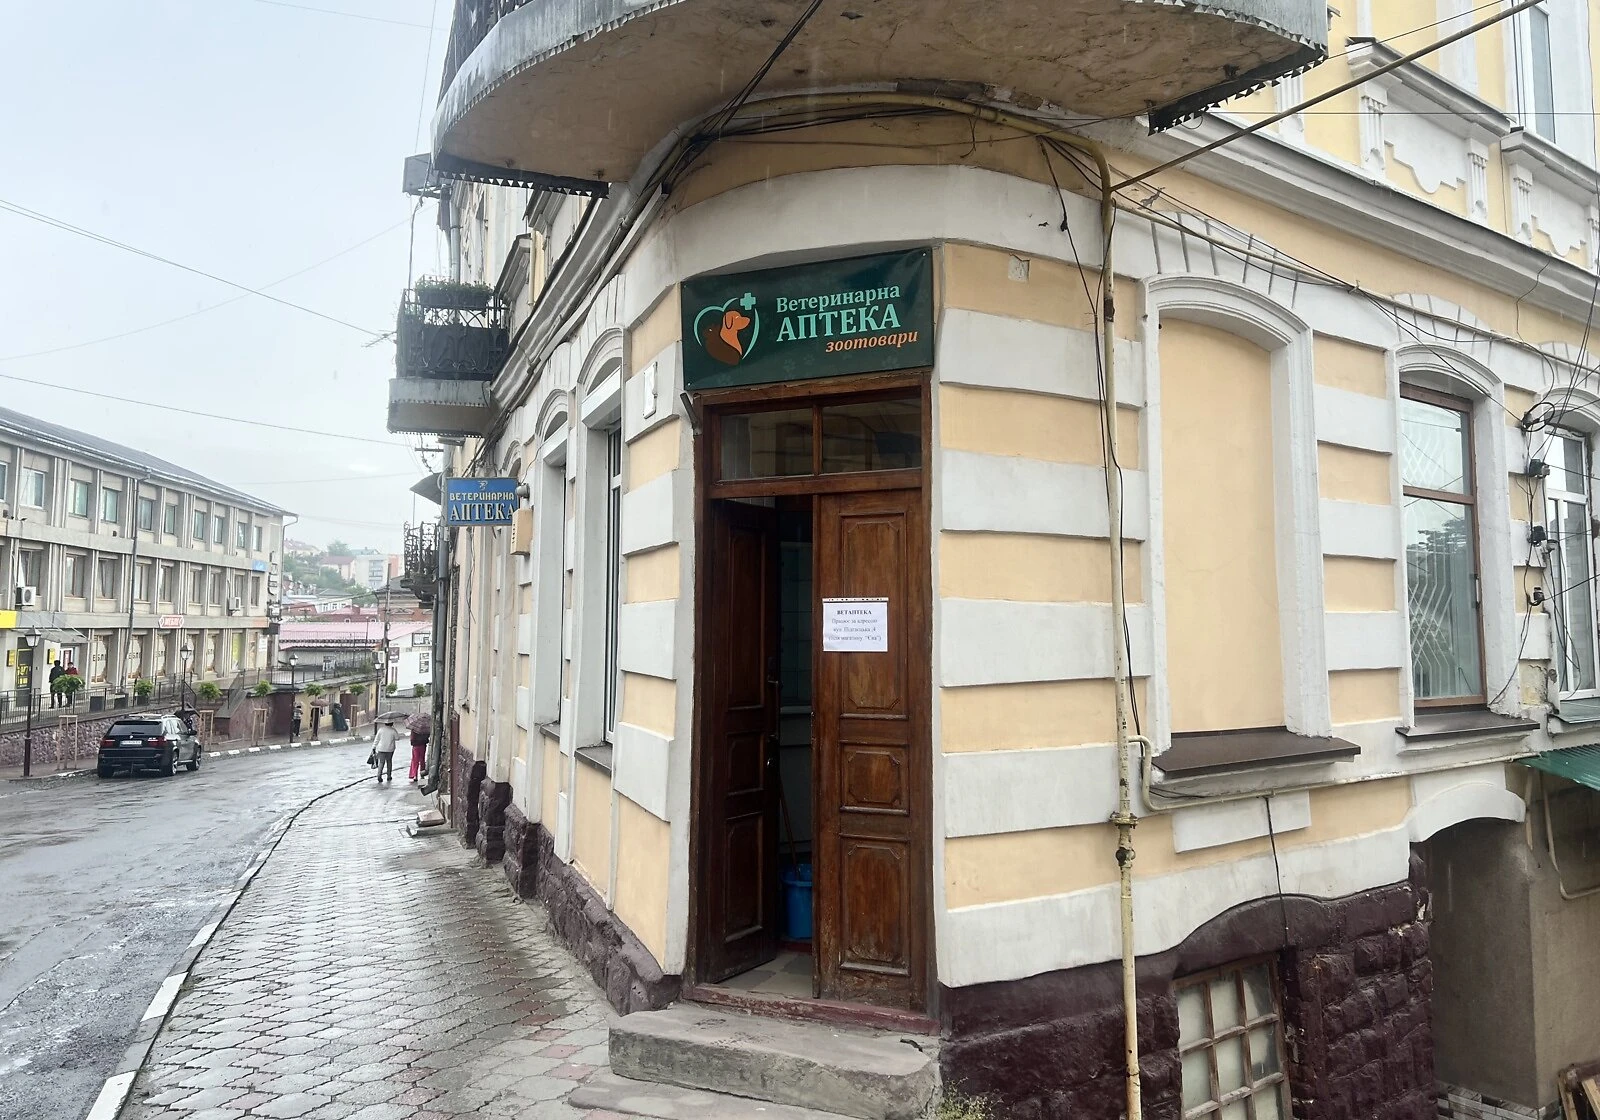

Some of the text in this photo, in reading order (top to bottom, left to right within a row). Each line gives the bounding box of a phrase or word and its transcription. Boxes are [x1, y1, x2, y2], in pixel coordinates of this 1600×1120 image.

[776, 284, 901, 313] Ветеринарна
[776, 303, 901, 342] АПТЕКА
[825, 330, 919, 353] зоотовари
[449, 492, 515, 501] ВЕТЕРИНАРНА
[450, 503, 515, 521] АПТЕКА
